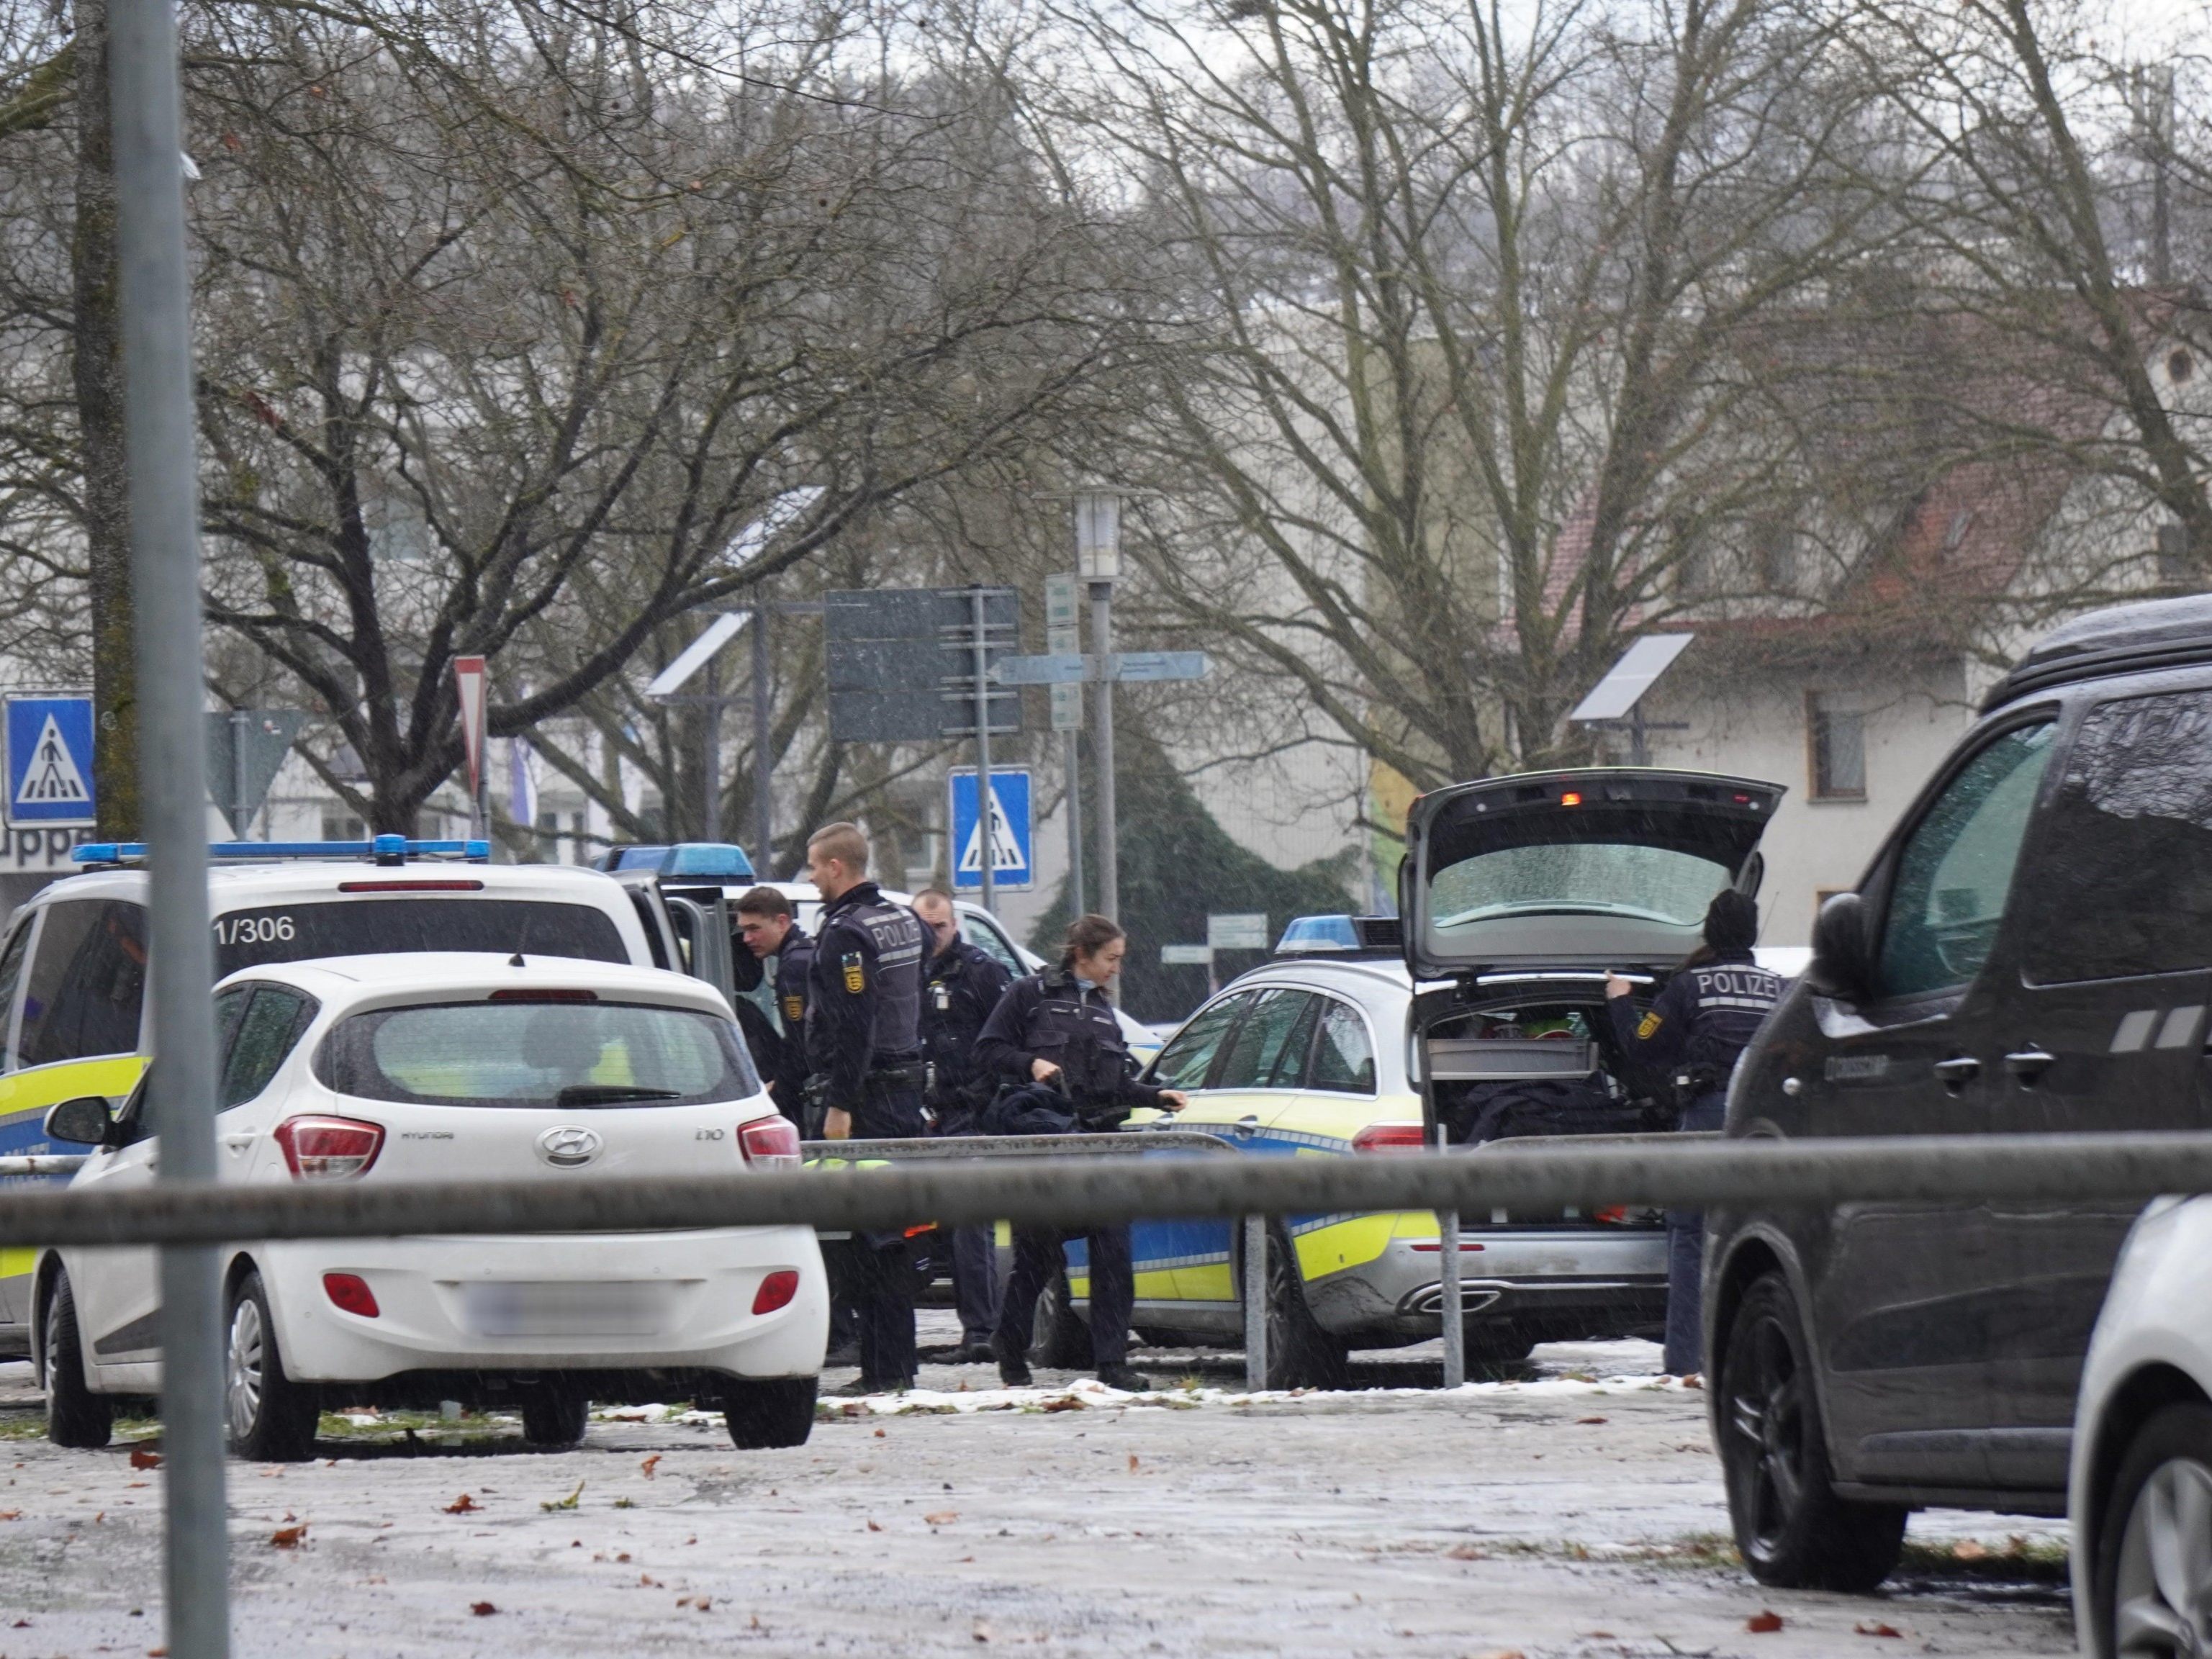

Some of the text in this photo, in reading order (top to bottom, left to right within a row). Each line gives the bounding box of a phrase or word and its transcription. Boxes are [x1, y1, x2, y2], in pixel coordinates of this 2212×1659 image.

[213, 916, 295, 944] 1/306
[871, 919, 922, 950] POLIZE
[1697, 972, 1782, 998] POLIZEI
[401, 1131, 454, 1140] HYUNDAI
[695, 1127, 725, 1141] i10
